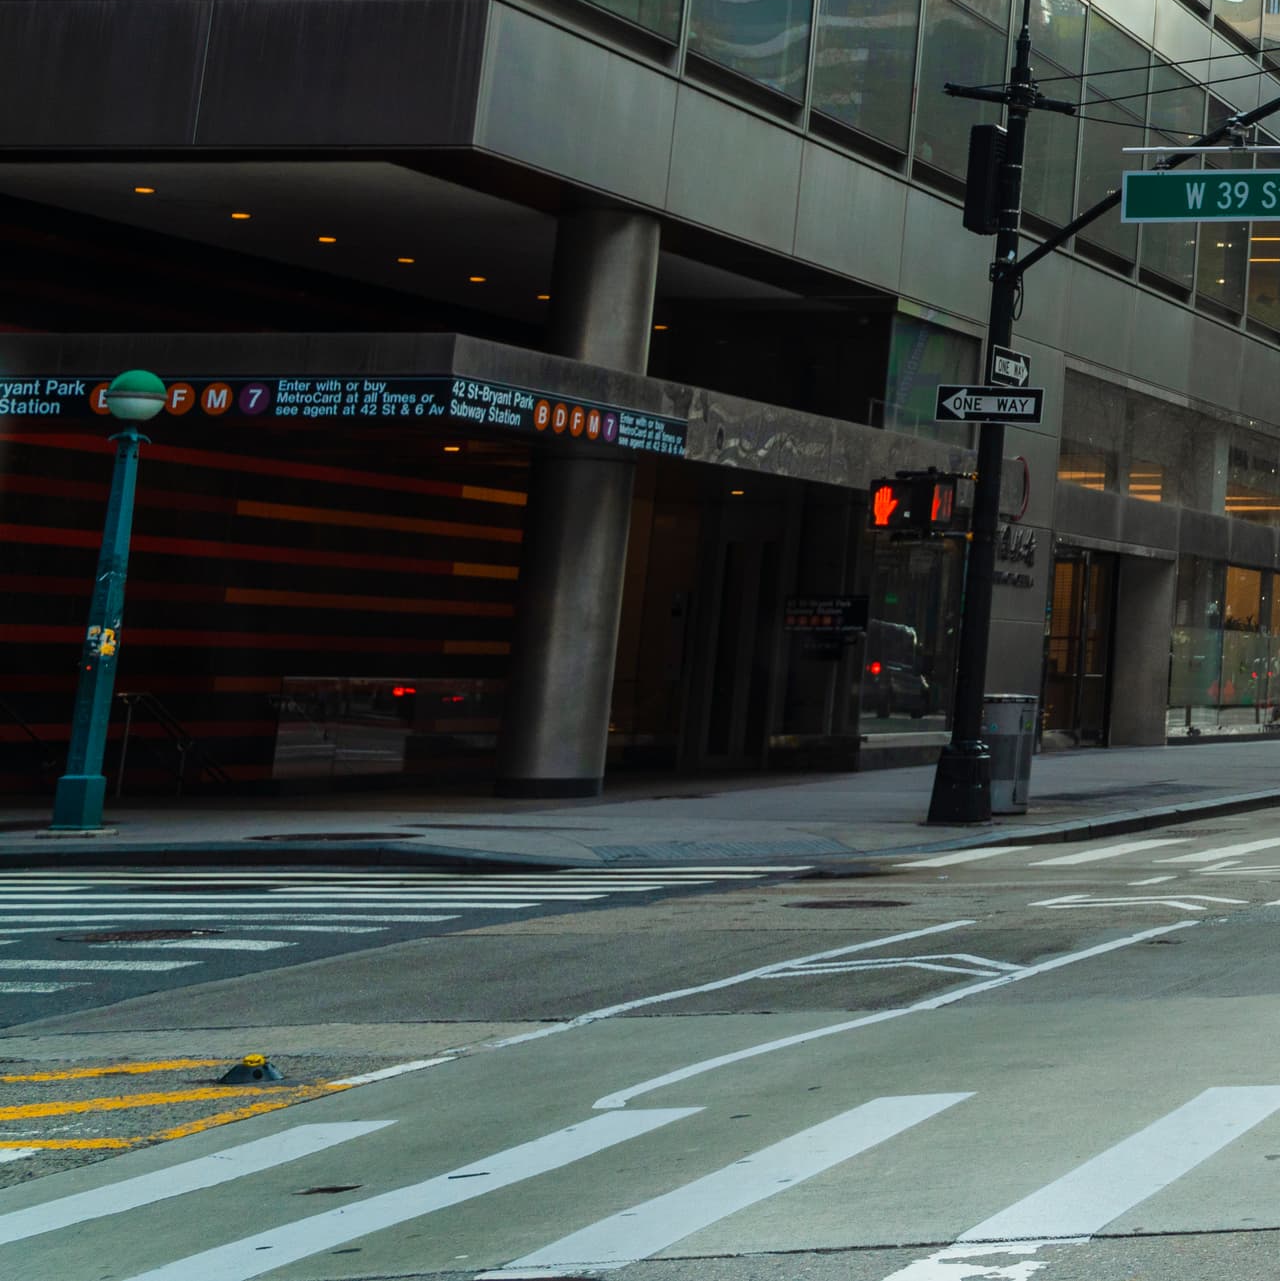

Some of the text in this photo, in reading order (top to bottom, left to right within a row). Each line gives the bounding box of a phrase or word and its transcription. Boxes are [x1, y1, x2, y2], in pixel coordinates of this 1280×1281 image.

[1186, 182, 1206, 209] W
[1217, 181, 1249, 209] 39
[999, 359, 1026, 377] ONE WAY
[45, 380, 86, 396] Park
[278, 379, 387, 394] Enter with or buy
[172, 389, 262, 409] F M 7
[276, 391, 435, 404] MetroCard at all times or
[452, 381, 534, 410] 42 St-Bryant Park
[0, 398, 60, 415] Station
[275, 405, 445, 417] see agent at 42 St & 6 Av
[450, 399, 521, 426] Subway Station
[953, 397, 1029, 412] ONE WAY
[538, 406, 614, 435] B D F M 7
